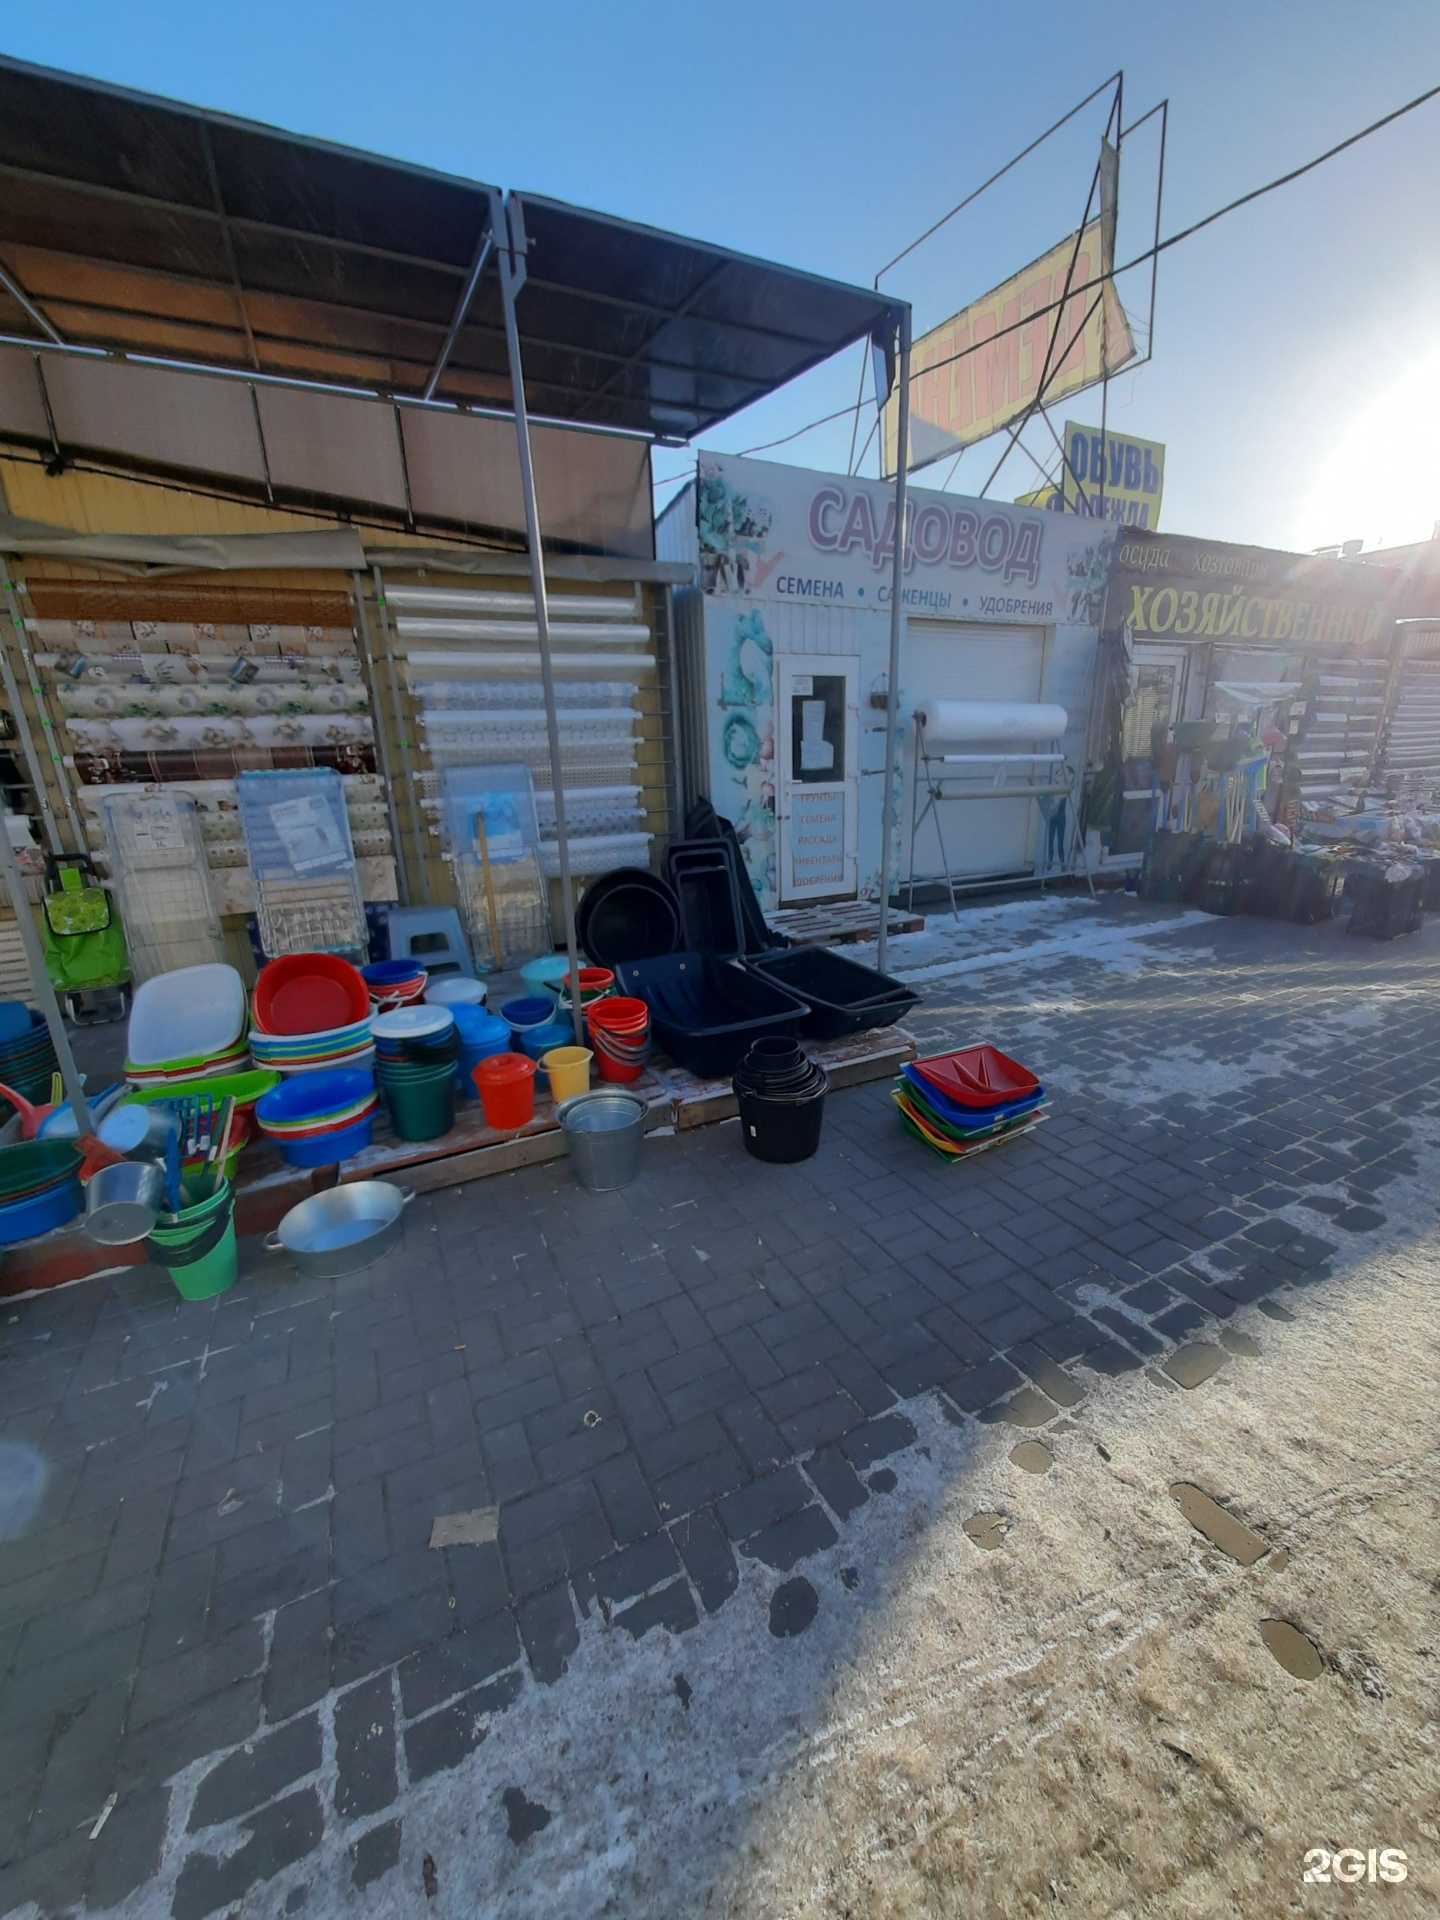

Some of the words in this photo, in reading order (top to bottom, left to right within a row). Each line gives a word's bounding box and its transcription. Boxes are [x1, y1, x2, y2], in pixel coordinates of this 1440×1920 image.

[1071, 432, 1159, 494] ОБУВЬ
[808, 486, 1043, 586] САДОВОД
[1119, 544, 1170, 571] осуда
[776, 576, 844, 599] СЕМЕНА
[979, 596, 1053, 616] УДОБРЕНИЯ
[1127, 584, 1386, 642] ХОЗЯЙСТВЕННЫЙ
